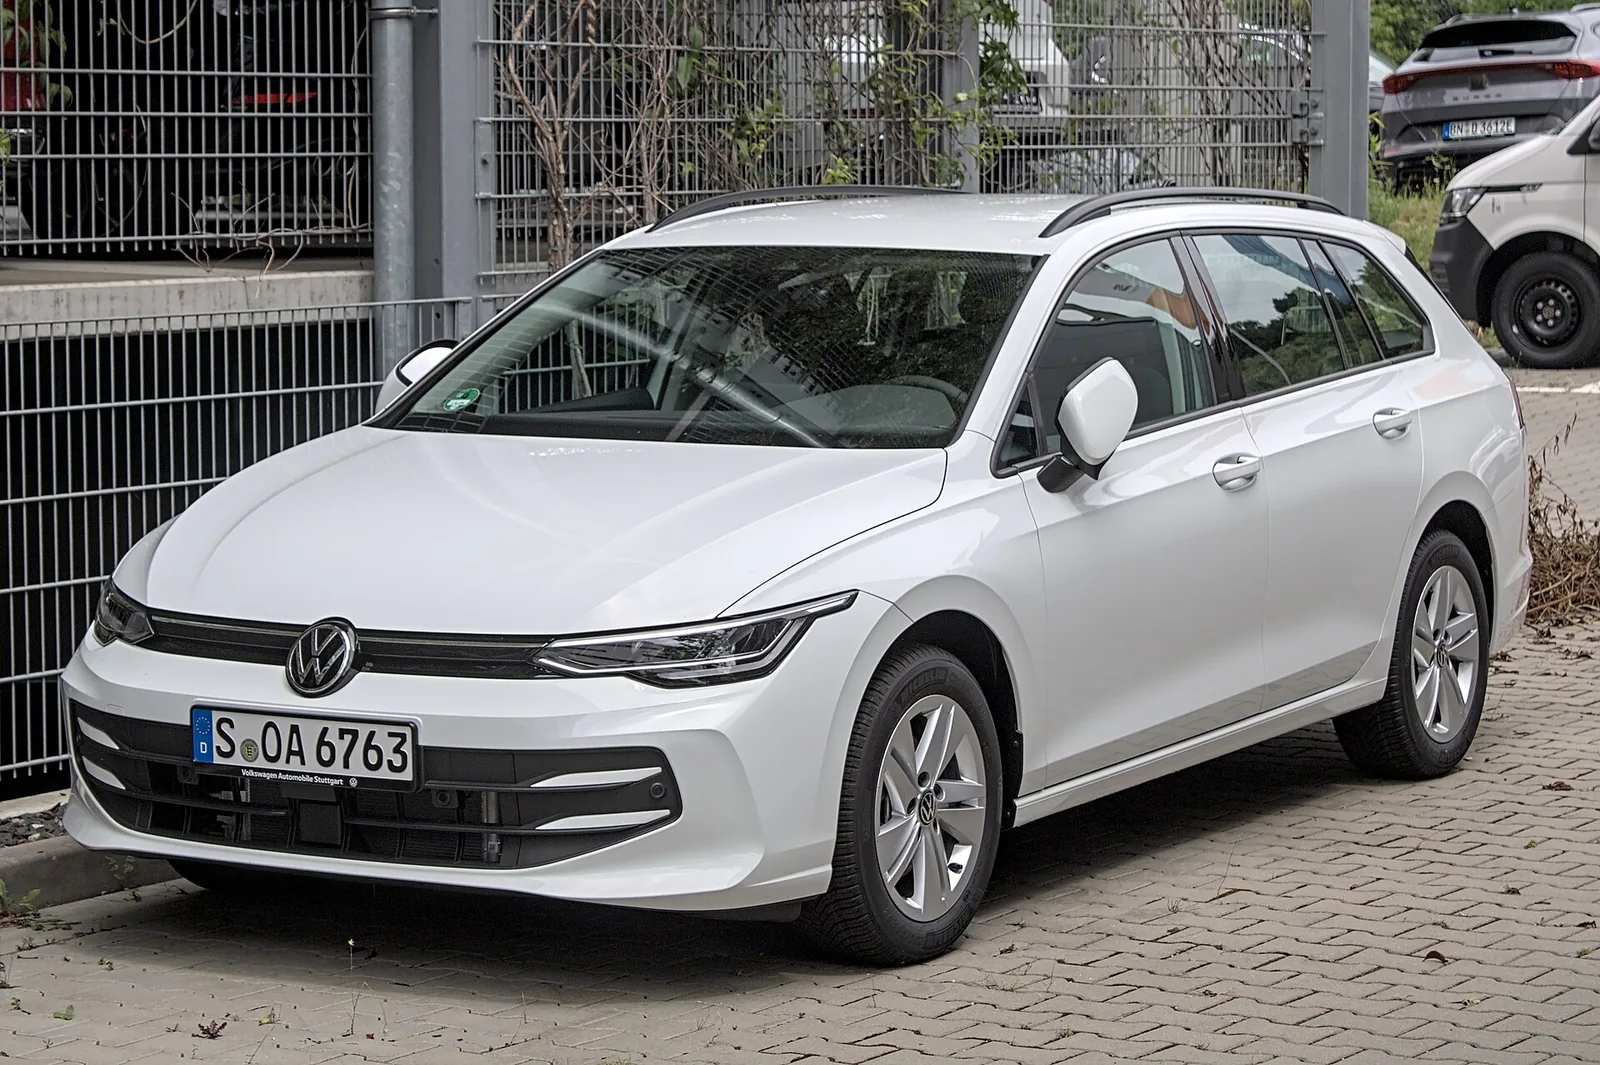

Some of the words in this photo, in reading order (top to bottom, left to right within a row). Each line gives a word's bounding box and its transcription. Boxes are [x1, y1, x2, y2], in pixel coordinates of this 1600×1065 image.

[200, 742, 208, 754] D
[215, 717, 236, 759] S
[261, 721, 306, 766] OA
[315, 726, 408, 773] 6763
[241, 768, 277, 780] Volkswagen
[278, 772, 314, 783] Automobile
[314, 776, 344, 786] Stuttgart
